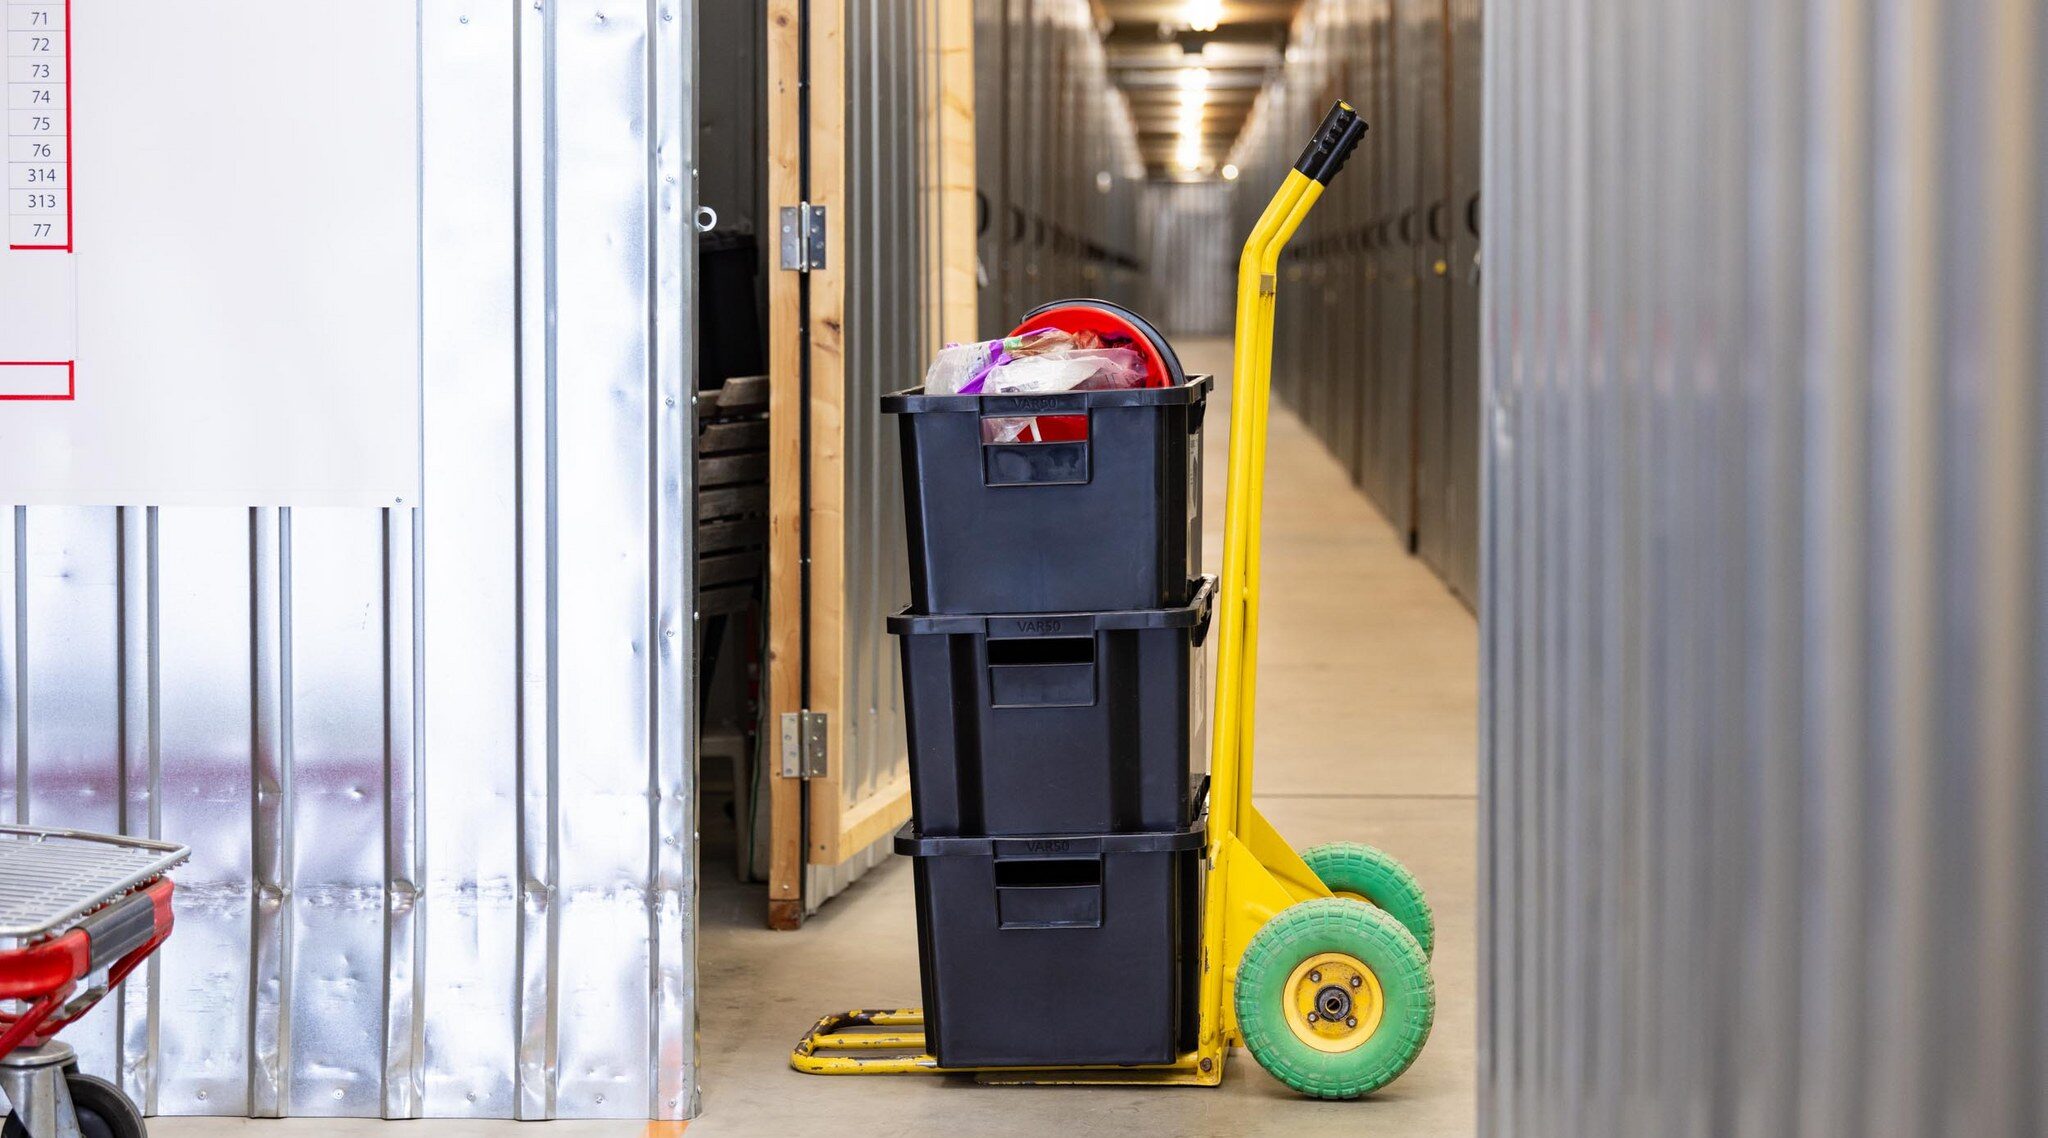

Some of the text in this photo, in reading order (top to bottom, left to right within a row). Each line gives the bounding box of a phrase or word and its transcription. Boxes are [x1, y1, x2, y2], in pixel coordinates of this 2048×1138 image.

[31, 12, 48, 25] 71
[31, 38, 50, 51] 72
[32, 64, 50, 78] 73
[32, 90, 50, 104] 74
[32, 117, 50, 130] 75
[33, 143, 51, 157] 76
[28, 168, 56, 182] 314
[28, 194, 56, 208] 313
[33, 223, 51, 237] 77
[1017, 620, 1061, 633] VAR50
[1026, 840, 1070, 853] VAR50
